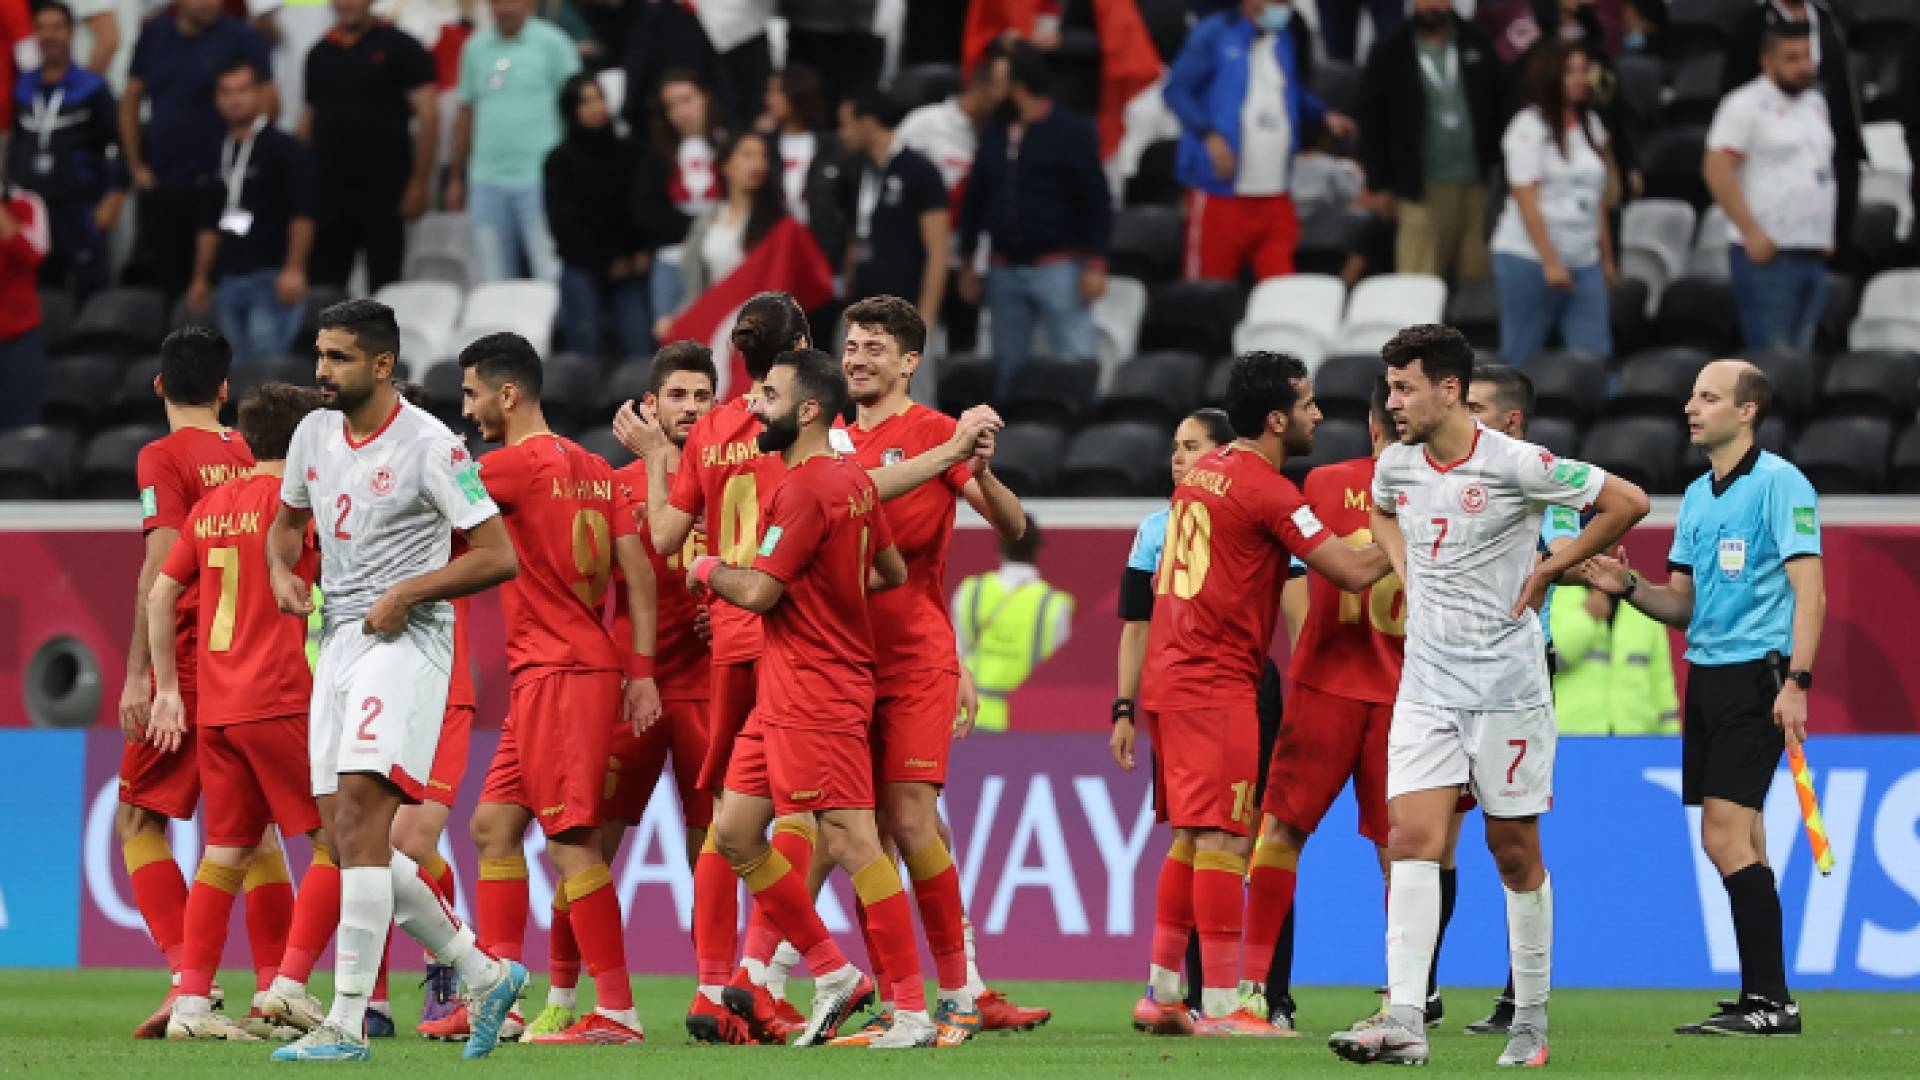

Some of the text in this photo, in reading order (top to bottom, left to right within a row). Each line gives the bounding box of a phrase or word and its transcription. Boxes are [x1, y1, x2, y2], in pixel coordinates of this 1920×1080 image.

[335, 493, 351, 540] 2
[1431, 518, 1448, 560] 7
[572, 509, 610, 608] 9
[1156, 500, 1211, 600] 19
[208, 546, 238, 652] 7
[357, 696, 382, 740] 2
[1507, 739, 1526, 784] 7
